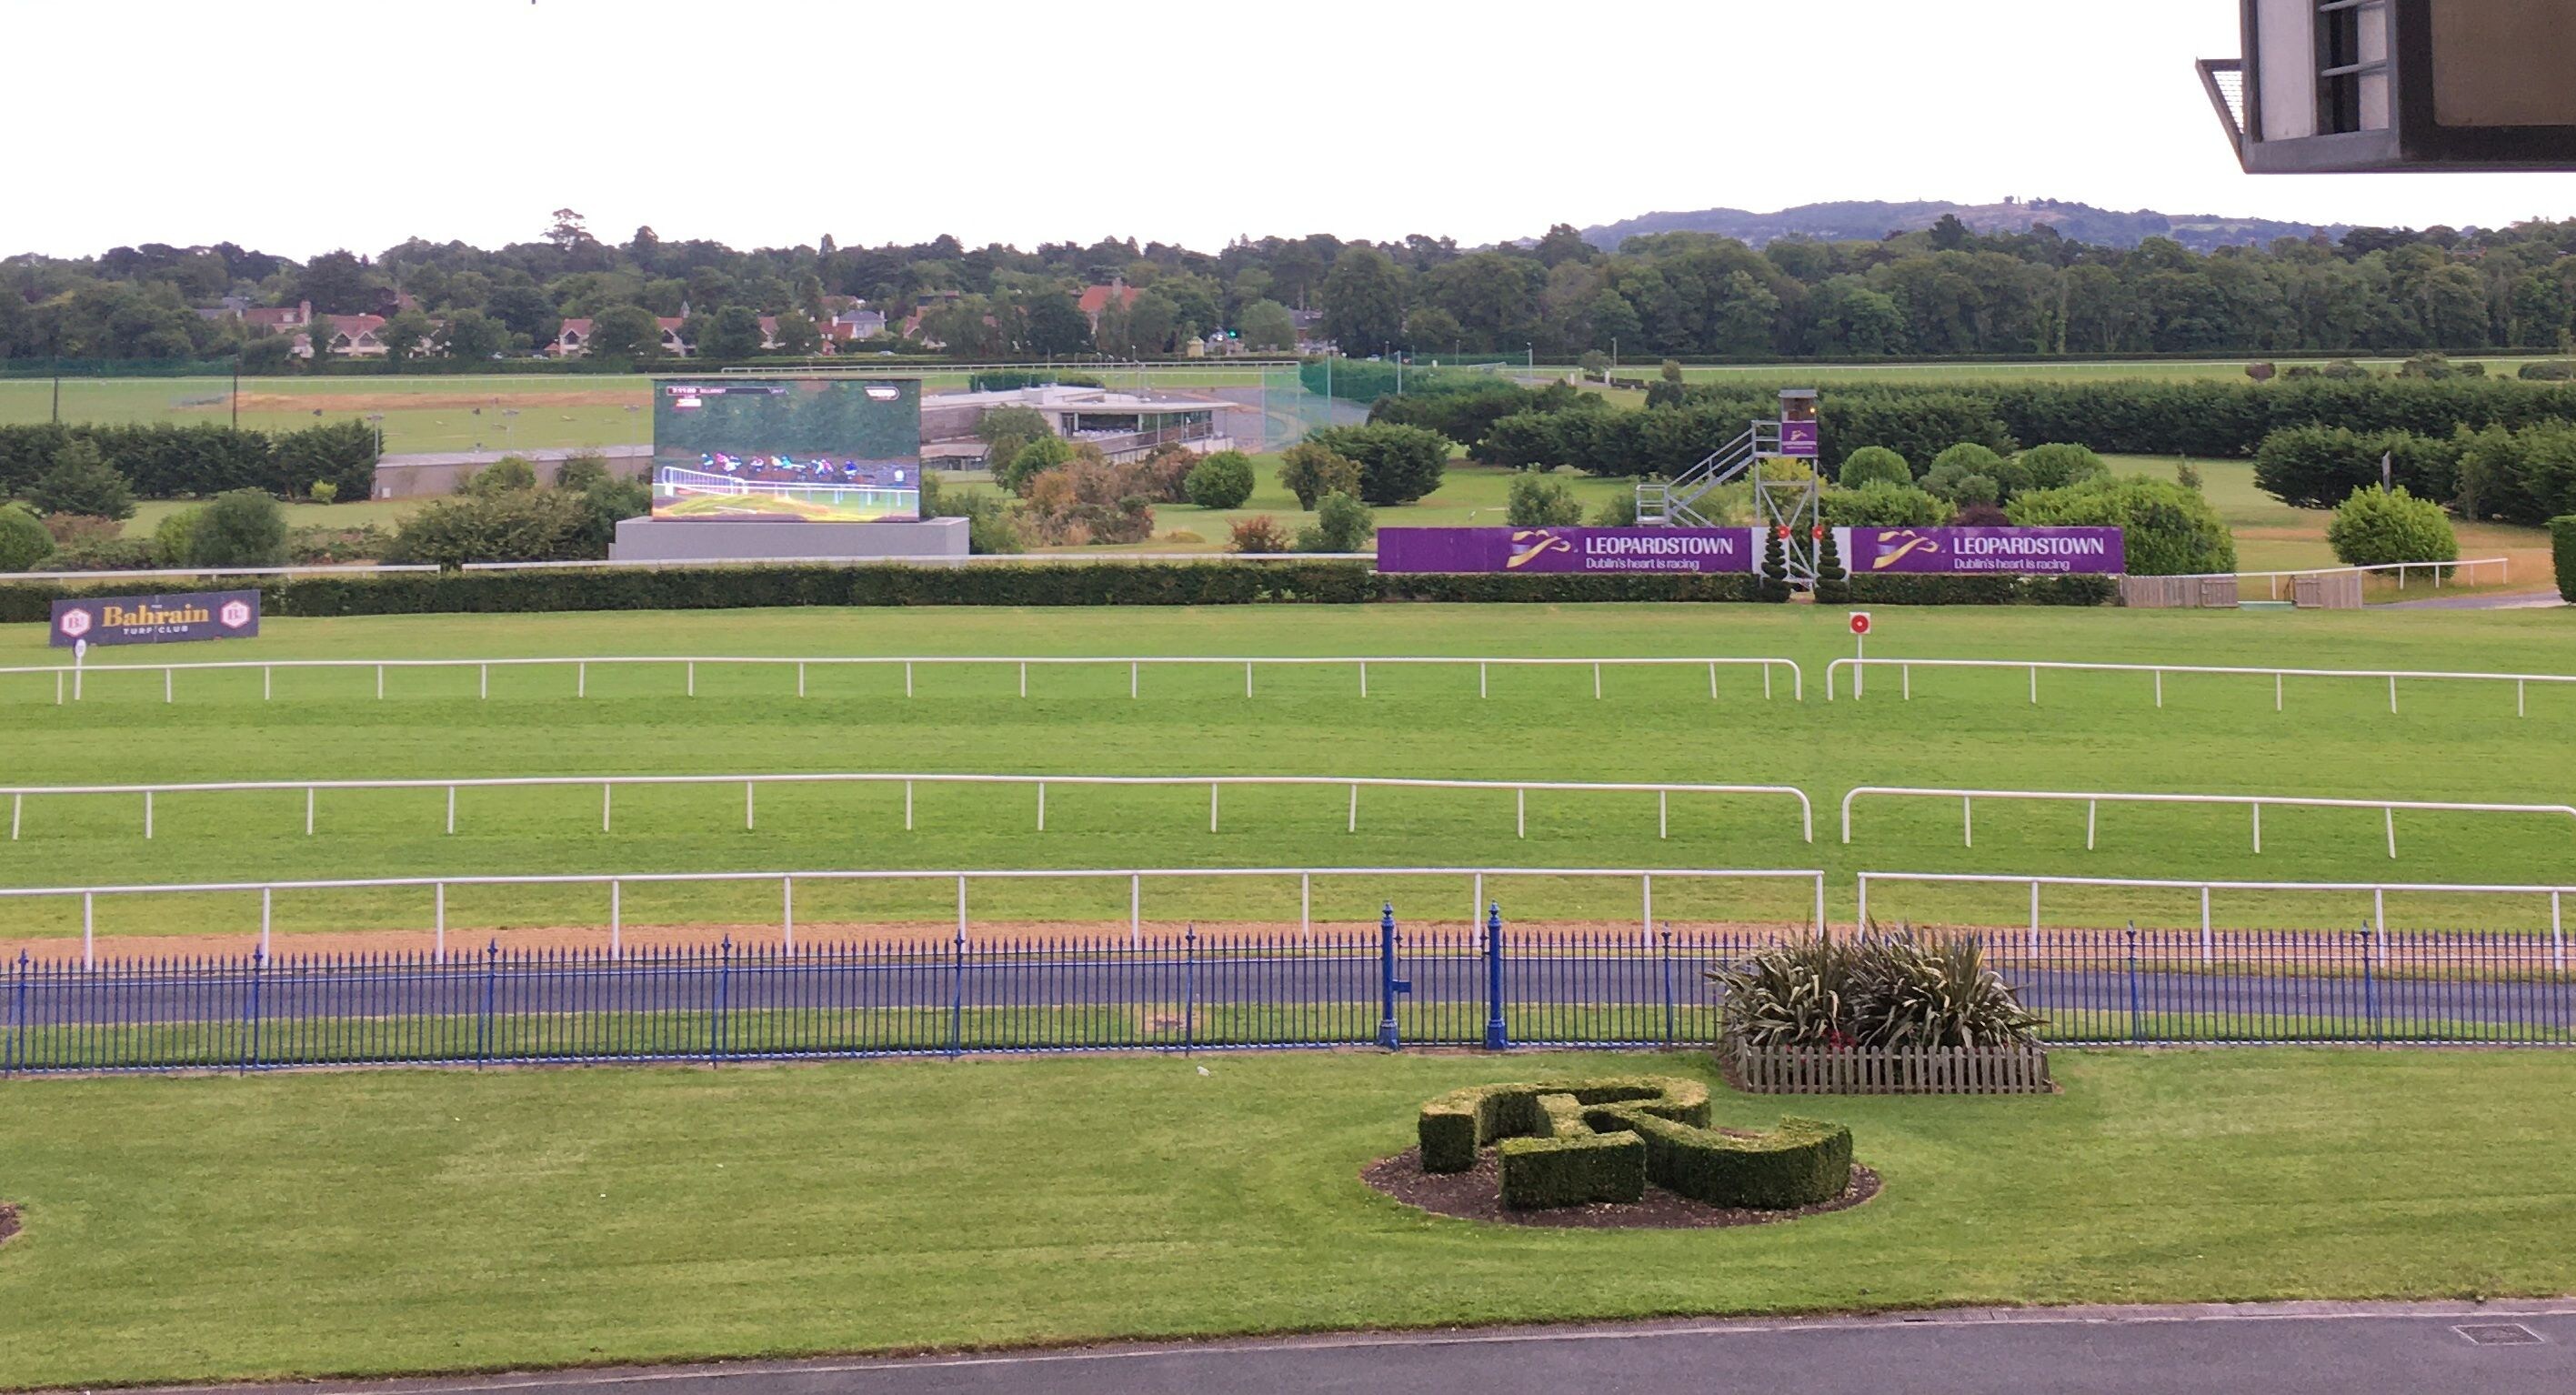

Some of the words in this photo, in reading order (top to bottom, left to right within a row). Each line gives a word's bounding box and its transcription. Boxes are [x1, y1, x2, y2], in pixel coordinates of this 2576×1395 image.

[1586, 537, 1733, 555] LEOPARDSTOWN
[1953, 537, 2104, 555] LEOPARDSTOWN
[1586, 557, 1626, 569] Dublin's
[1628, 557, 1655, 569] heart
[1657, 558, 1666, 569] is
[1667, 558, 1700, 571] racing
[1954, 557, 1995, 569] Dublin's
[1996, 557, 2024, 569] heart
[2026, 558, 2035, 569] is
[2036, 558, 2070, 571] racing
[102, 603, 209, 627] Bahrain
[123, 627, 153, 635] TURF
[158, 625, 188, 634] CLUB
